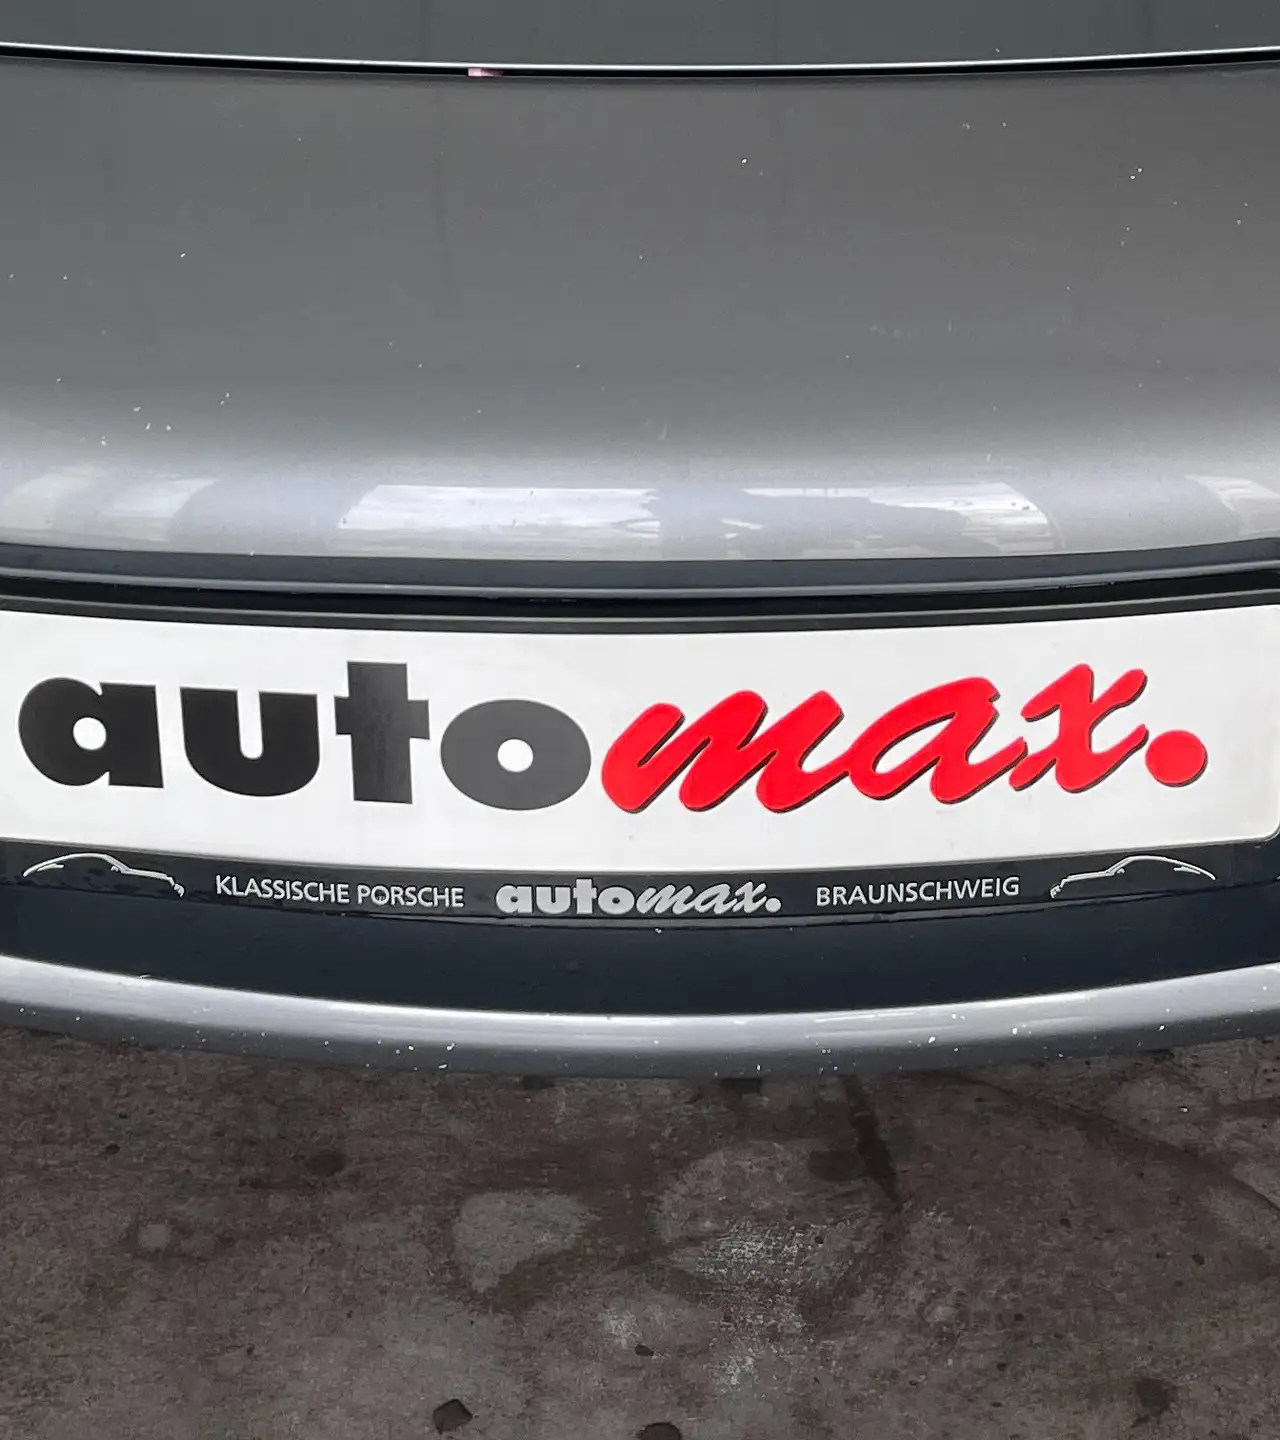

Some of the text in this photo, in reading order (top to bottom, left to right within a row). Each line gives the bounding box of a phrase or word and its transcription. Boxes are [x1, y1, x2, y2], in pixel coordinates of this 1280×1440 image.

[215, 874, 350, 905] KLASSISCHE
[356, 883, 465, 910] PORSCHE
[815, 875, 1020, 907] BRAUNSCHWEIG
